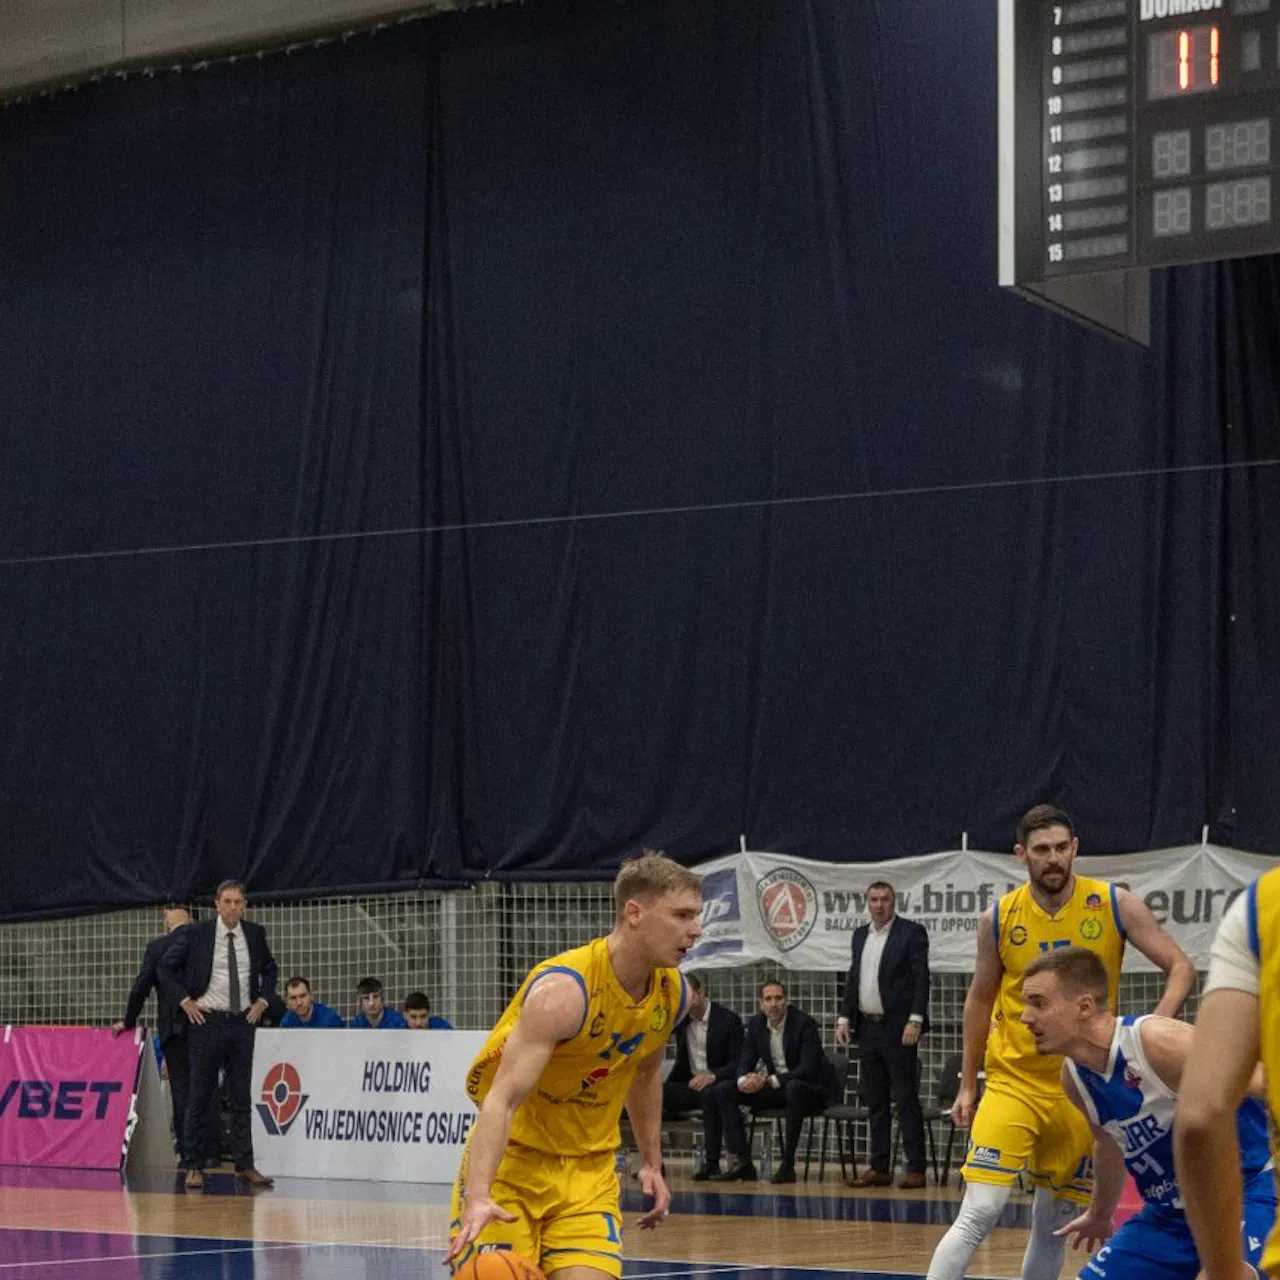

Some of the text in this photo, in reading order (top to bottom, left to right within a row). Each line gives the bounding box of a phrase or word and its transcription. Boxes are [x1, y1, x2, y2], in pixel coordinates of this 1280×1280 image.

[1052, 36, 1062, 55] 8
[1052, 66, 1062, 85] 9
[1047, 96, 1062, 115] 10
[1050, 125, 1062, 144] 11
[1048, 154, 1062, 173] 12
[1048, 183, 1063, 202] 13
[1048, 213, 1062, 232] 14
[1048, 243, 1063, 262] 15
[363, 1061, 431, 1093] HOLDING
[305, 1108, 477, 1145] VRIJEDNOSNICE OSIJE
